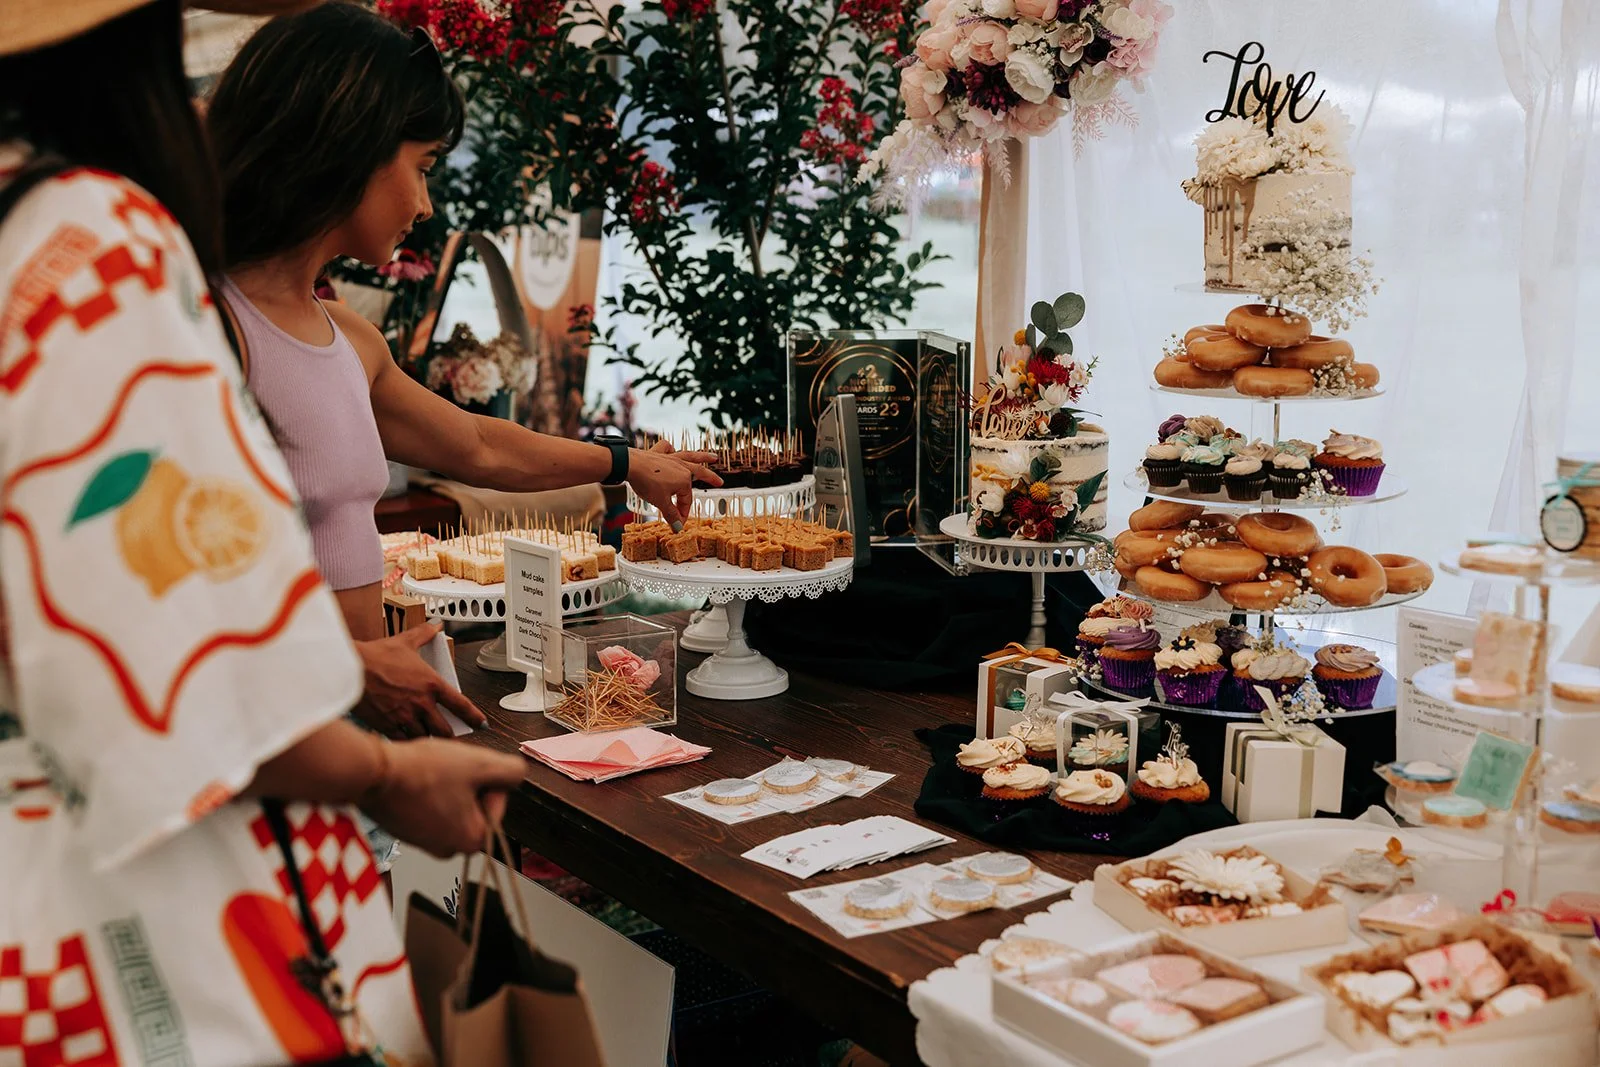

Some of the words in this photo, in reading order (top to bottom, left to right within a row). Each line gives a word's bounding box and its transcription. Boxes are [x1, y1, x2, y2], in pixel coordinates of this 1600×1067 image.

[1202, 41, 1326, 124] Love
[856, 406, 878, 414] ARDS
[879, 402, 900, 417] 23
[521, 569, 532, 580] Mud
[533, 574, 545, 584] cake
[523, 585, 544, 597] samples
[525, 606, 542, 617] Caramel
[515, 613, 535, 627] Raspberry
[519, 626, 529, 635] Dark
